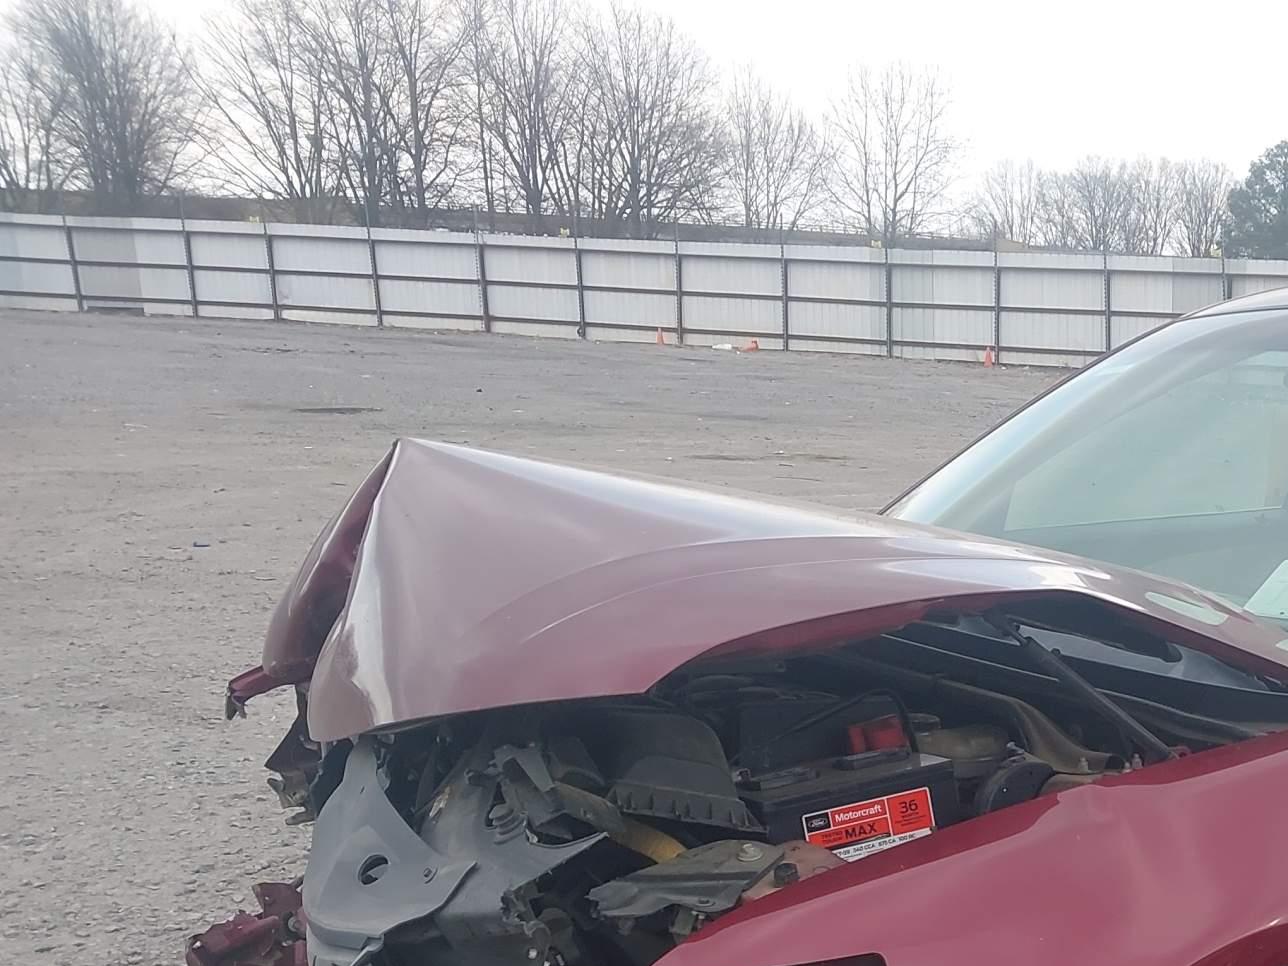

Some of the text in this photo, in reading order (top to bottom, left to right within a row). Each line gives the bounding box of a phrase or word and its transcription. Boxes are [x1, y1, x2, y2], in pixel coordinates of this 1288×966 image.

[834, 804, 882, 822] Motorcraft
[899, 799, 918, 814] 36
[844, 822, 877, 840] MAX
